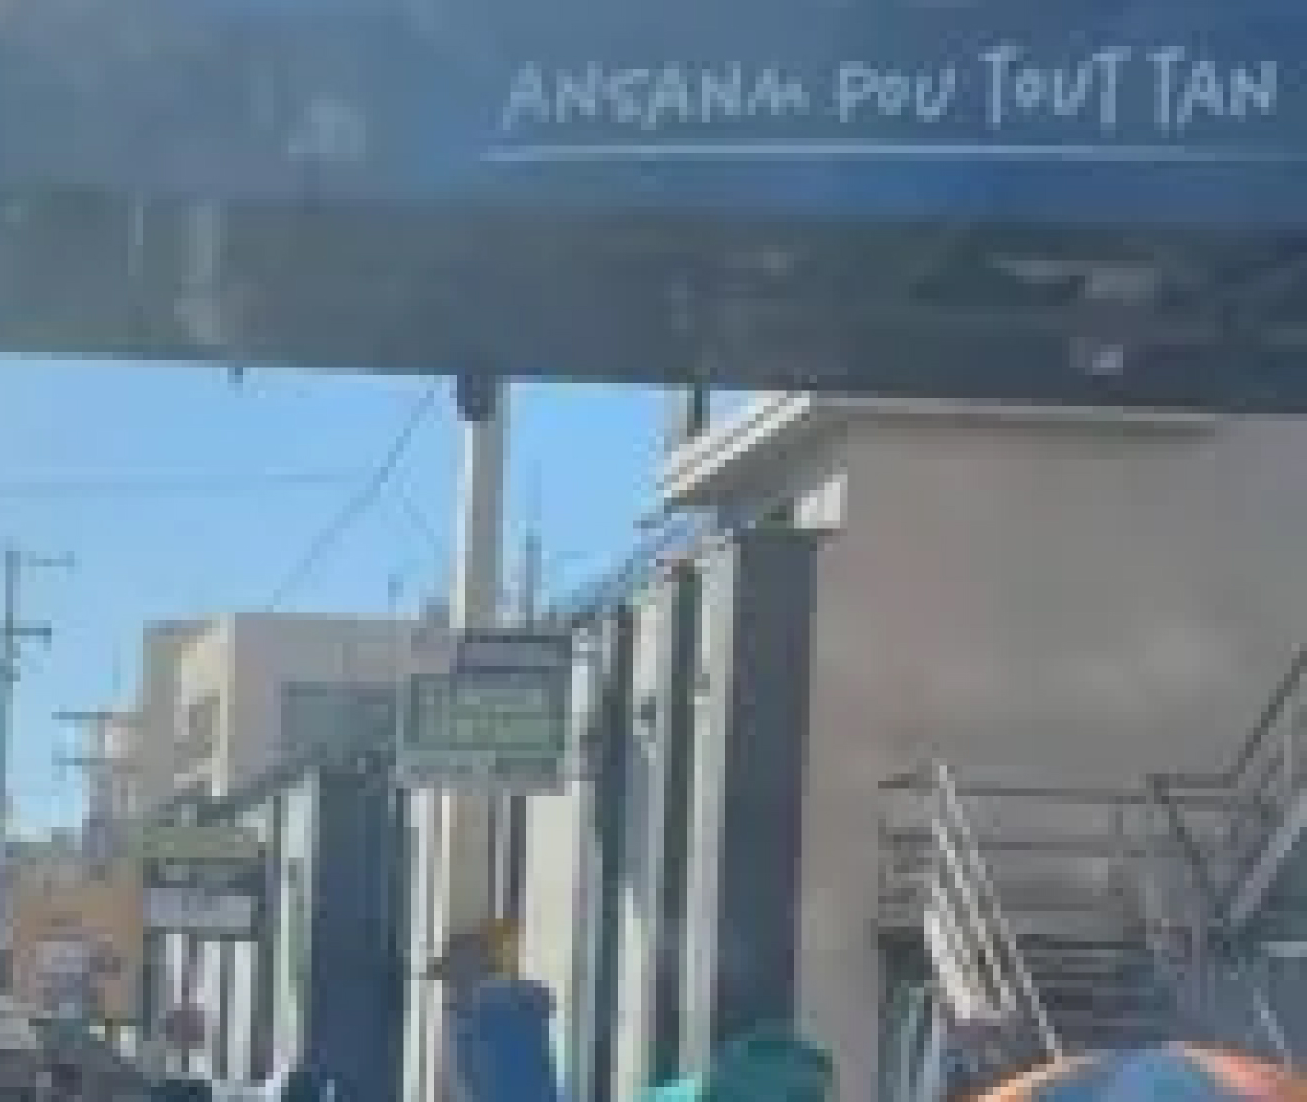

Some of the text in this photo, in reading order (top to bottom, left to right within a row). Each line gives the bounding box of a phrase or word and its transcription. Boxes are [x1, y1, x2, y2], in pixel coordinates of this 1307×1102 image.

[499, 44, 1280, 138] ANSANM POU TOUT TAN
